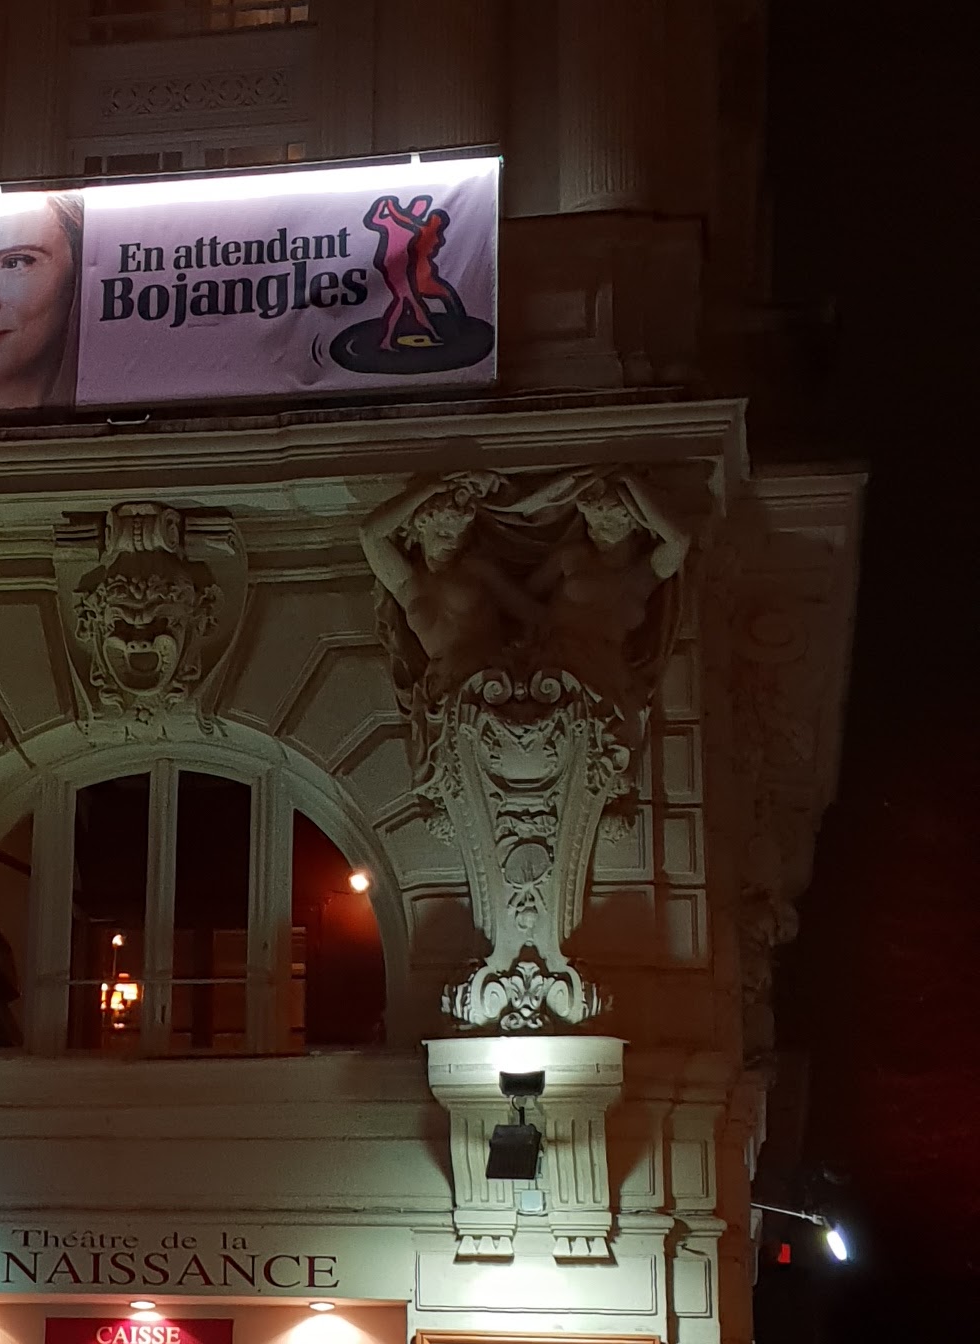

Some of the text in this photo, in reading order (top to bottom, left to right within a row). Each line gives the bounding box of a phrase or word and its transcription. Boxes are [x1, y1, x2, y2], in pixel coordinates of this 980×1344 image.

[118, 227, 351, 274] En attendant
[99, 261, 369, 328] Bojangles
[12, 1228, 249, 1252] Théâtre de la
